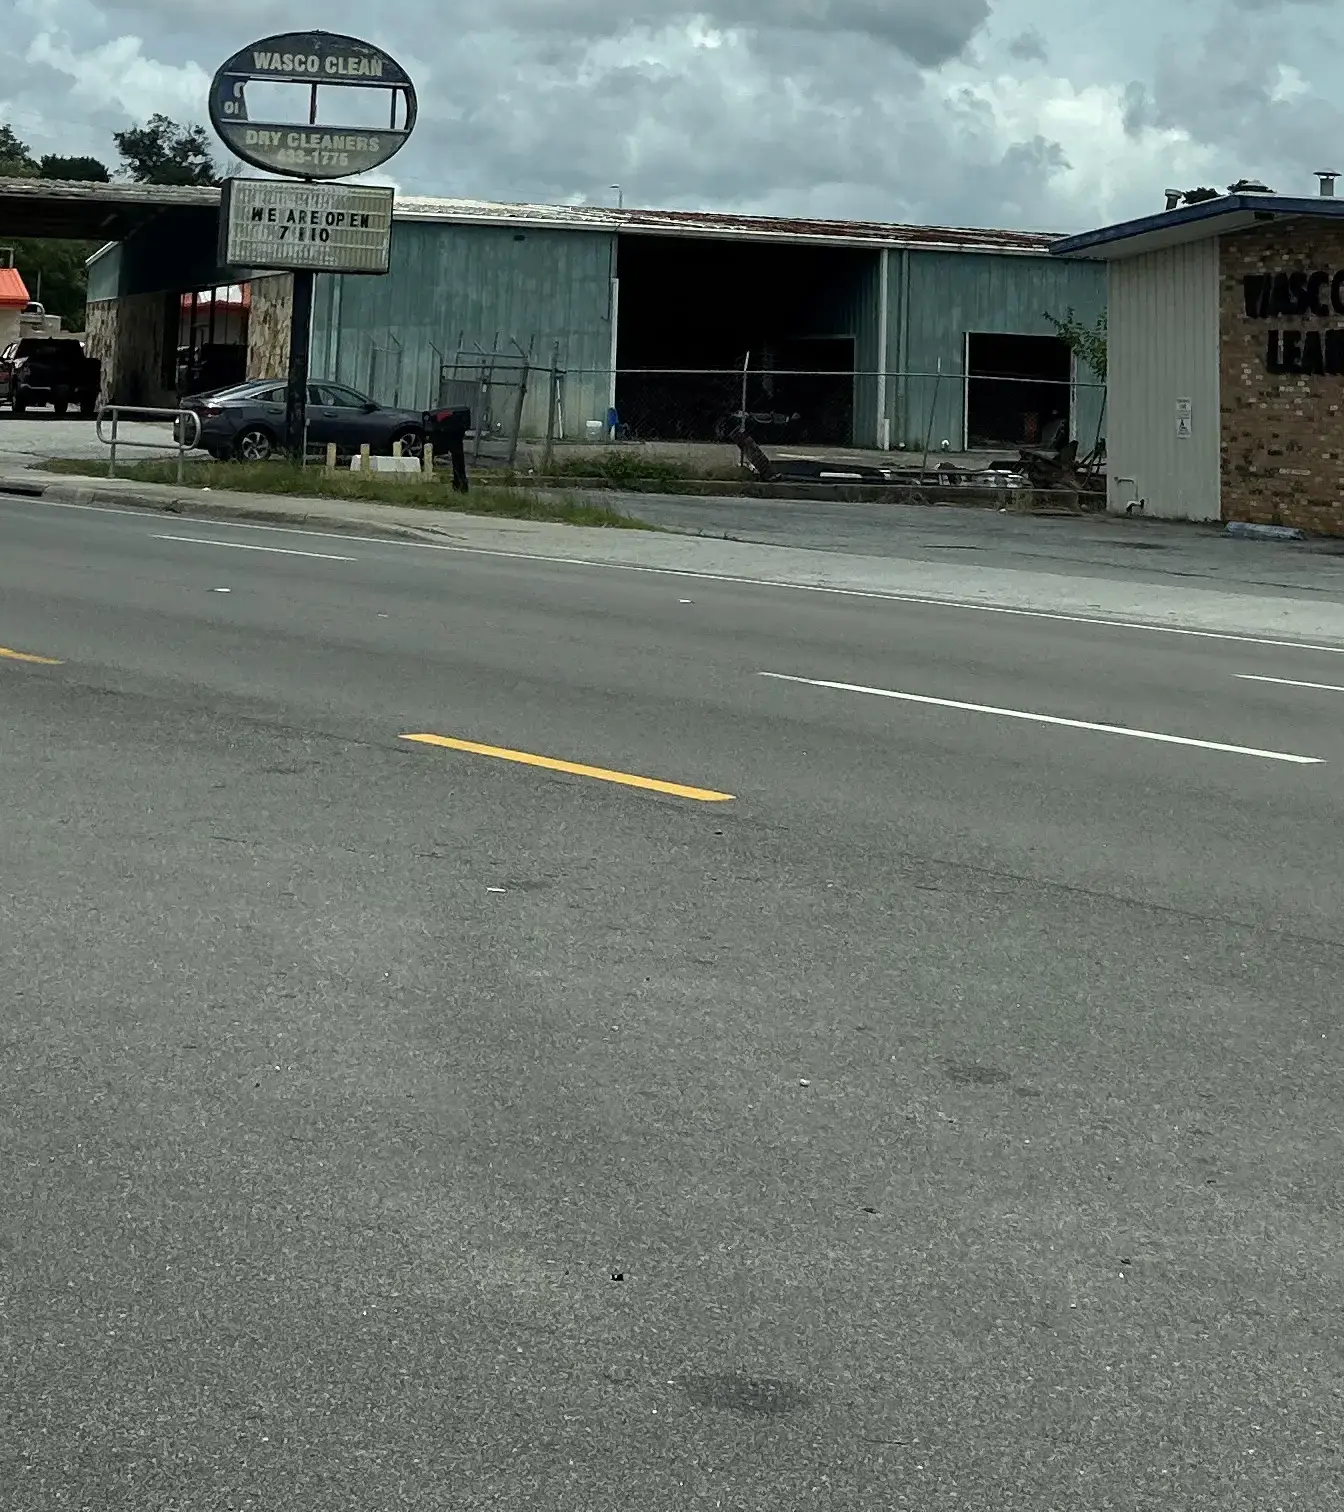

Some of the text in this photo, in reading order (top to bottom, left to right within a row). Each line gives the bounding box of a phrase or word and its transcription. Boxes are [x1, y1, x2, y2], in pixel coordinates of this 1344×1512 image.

[253, 51, 383, 77] WASCO CLEAN
[245, 129, 380, 152] DRY CLEANERS
[251, 207, 370, 228] WE ARE OPEN
